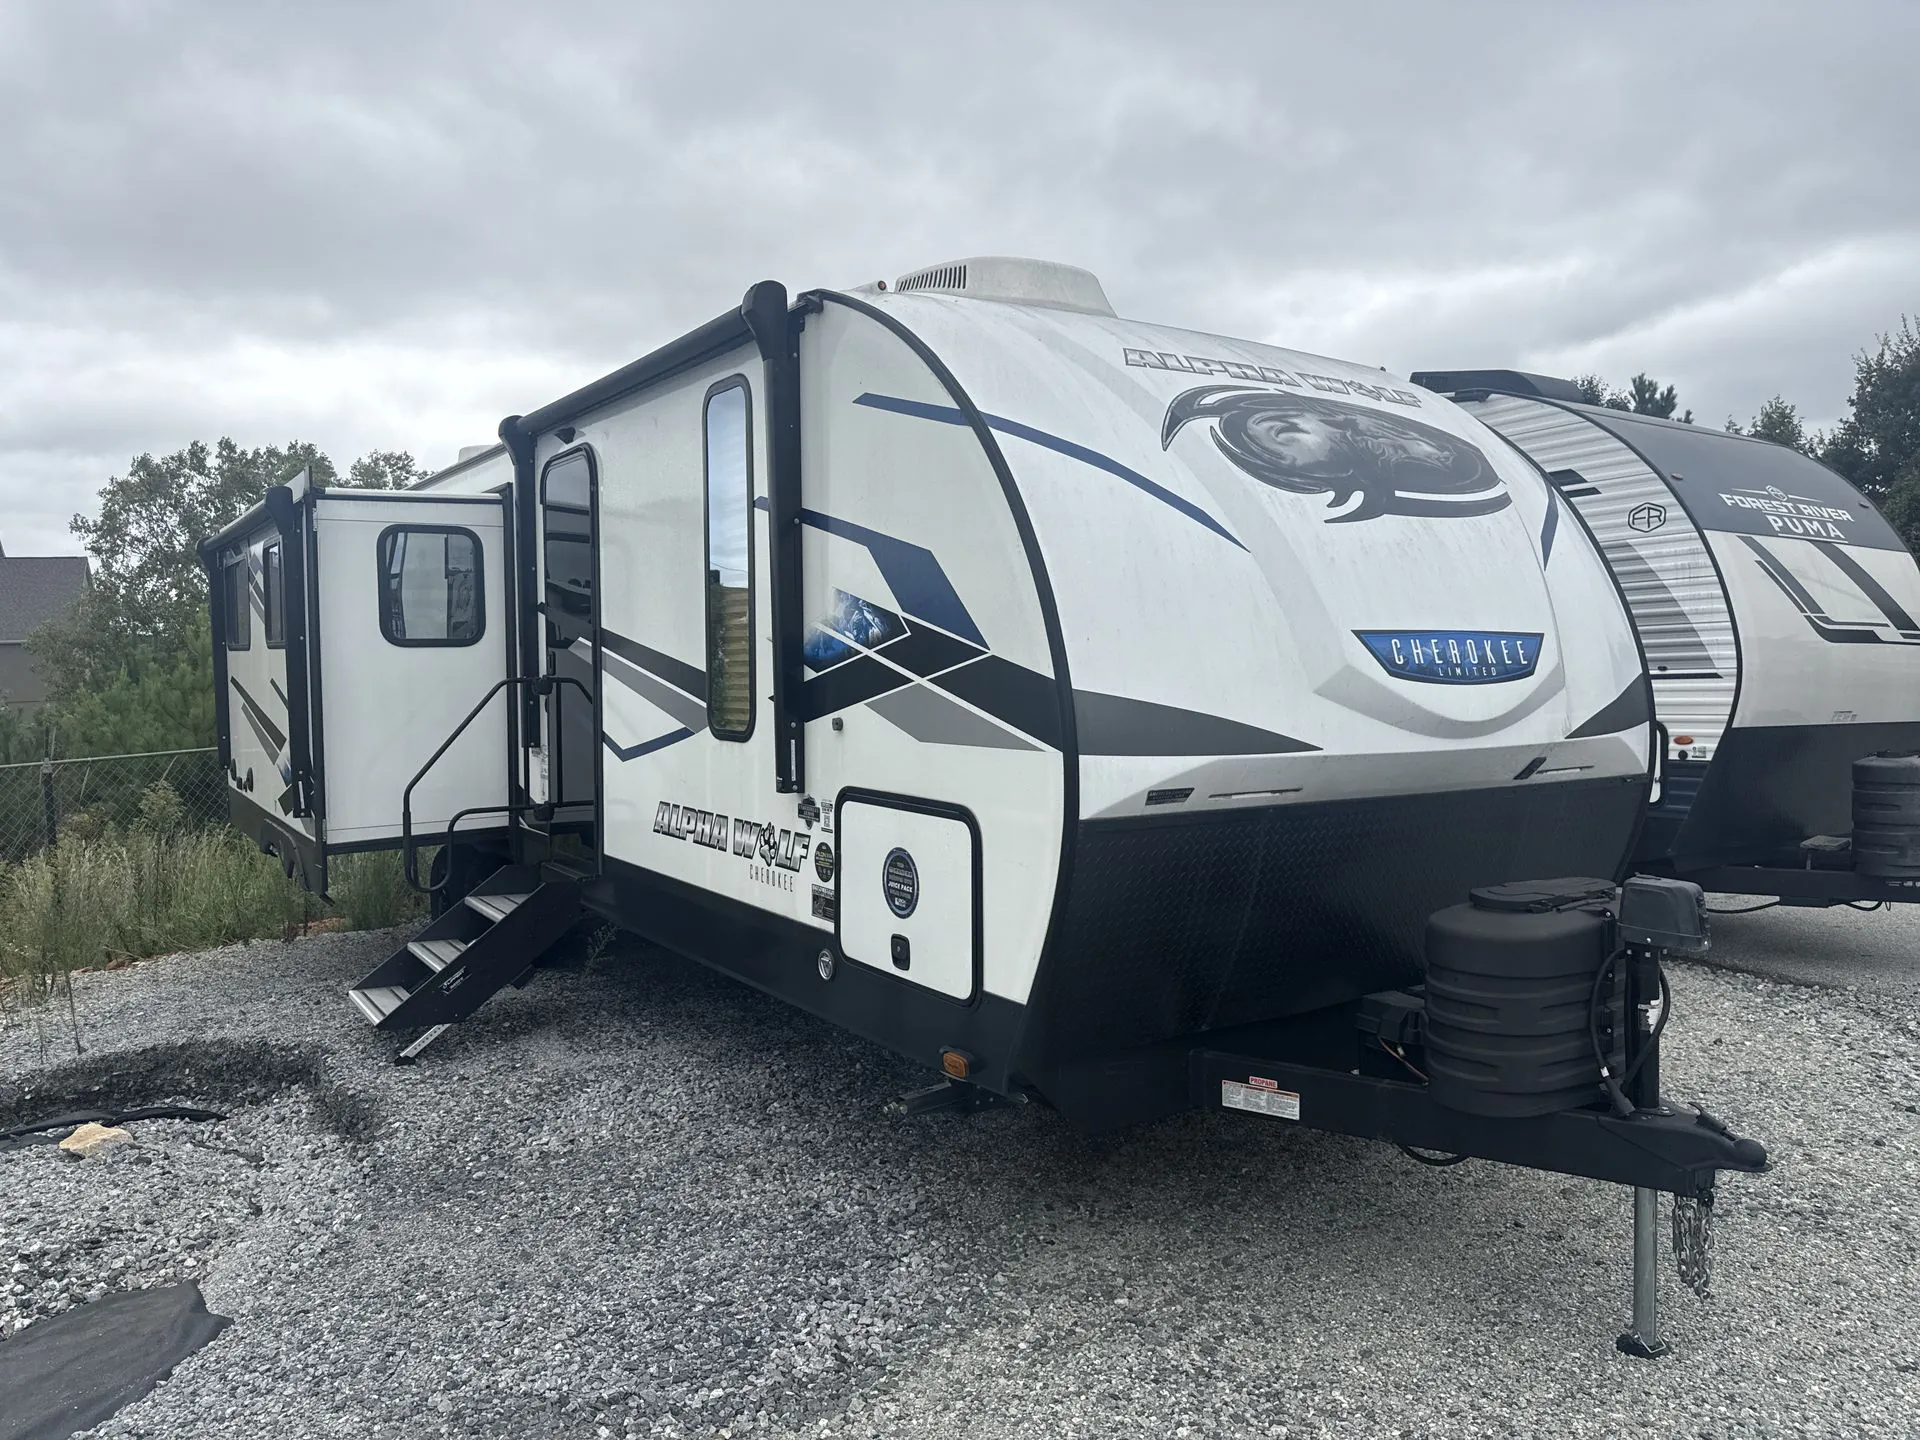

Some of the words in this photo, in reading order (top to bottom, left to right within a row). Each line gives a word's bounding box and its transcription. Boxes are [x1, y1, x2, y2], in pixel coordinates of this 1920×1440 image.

[1122, 348, 1302, 388] ALPHA
[1717, 493, 1797, 514] FOREST
[1796, 503, 1855, 522] RIVER
[1764, 514, 1846, 539] PUMA
[1391, 638, 1528, 665] CHEROKEE
[1438, 666, 1498, 677] LIMITED
[652, 800, 729, 852] ALPHA
[749, 863, 794, 893] CHEROKEE
[1250, 1077, 1277, 1088] PROPANE
